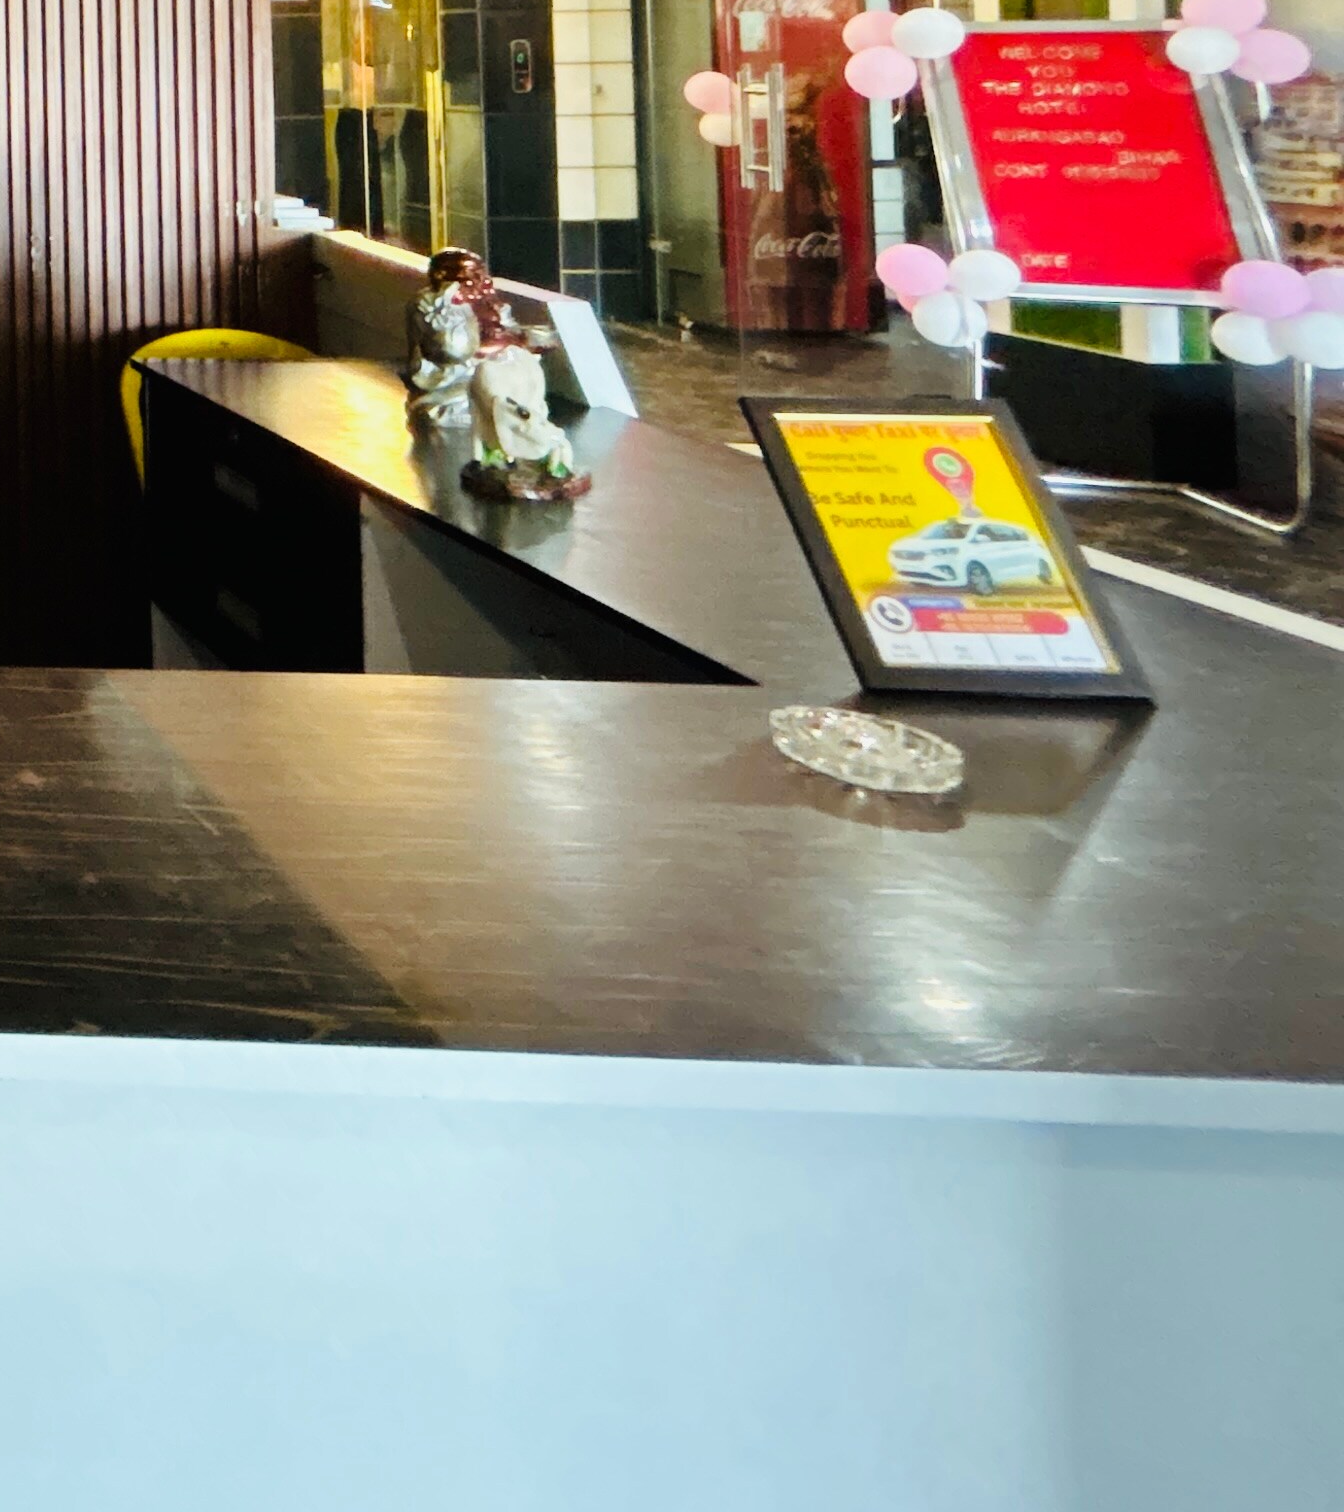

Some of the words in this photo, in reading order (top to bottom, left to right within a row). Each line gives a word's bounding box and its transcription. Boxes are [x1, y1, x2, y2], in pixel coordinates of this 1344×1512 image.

[1025, 64, 1076, 79] YOU
[981, 80, 1022, 96] THE
[833, 491, 875, 506] Safe
[830, 514, 912, 529] Punctual
